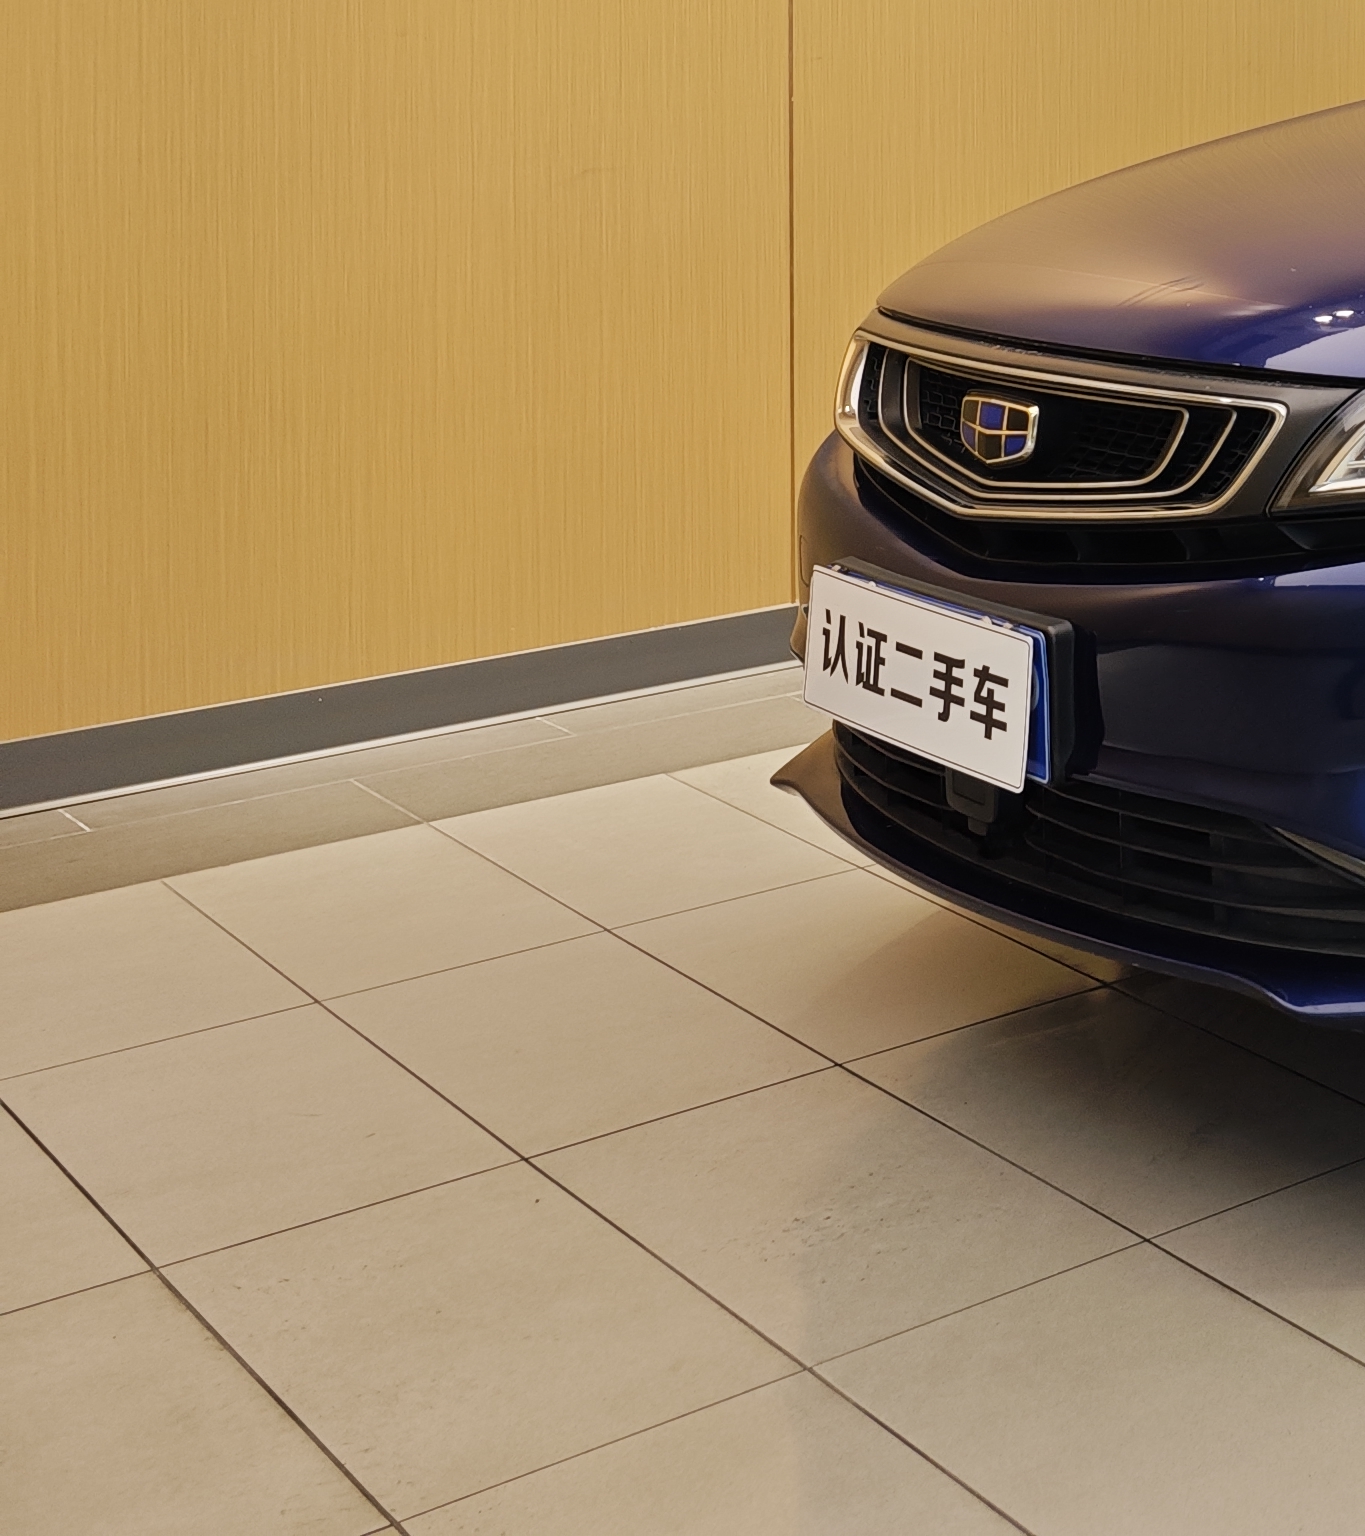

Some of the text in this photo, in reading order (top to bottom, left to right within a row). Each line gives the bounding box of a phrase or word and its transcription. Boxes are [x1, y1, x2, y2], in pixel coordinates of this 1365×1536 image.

[822, 608, 1010, 740] 认证二手车
